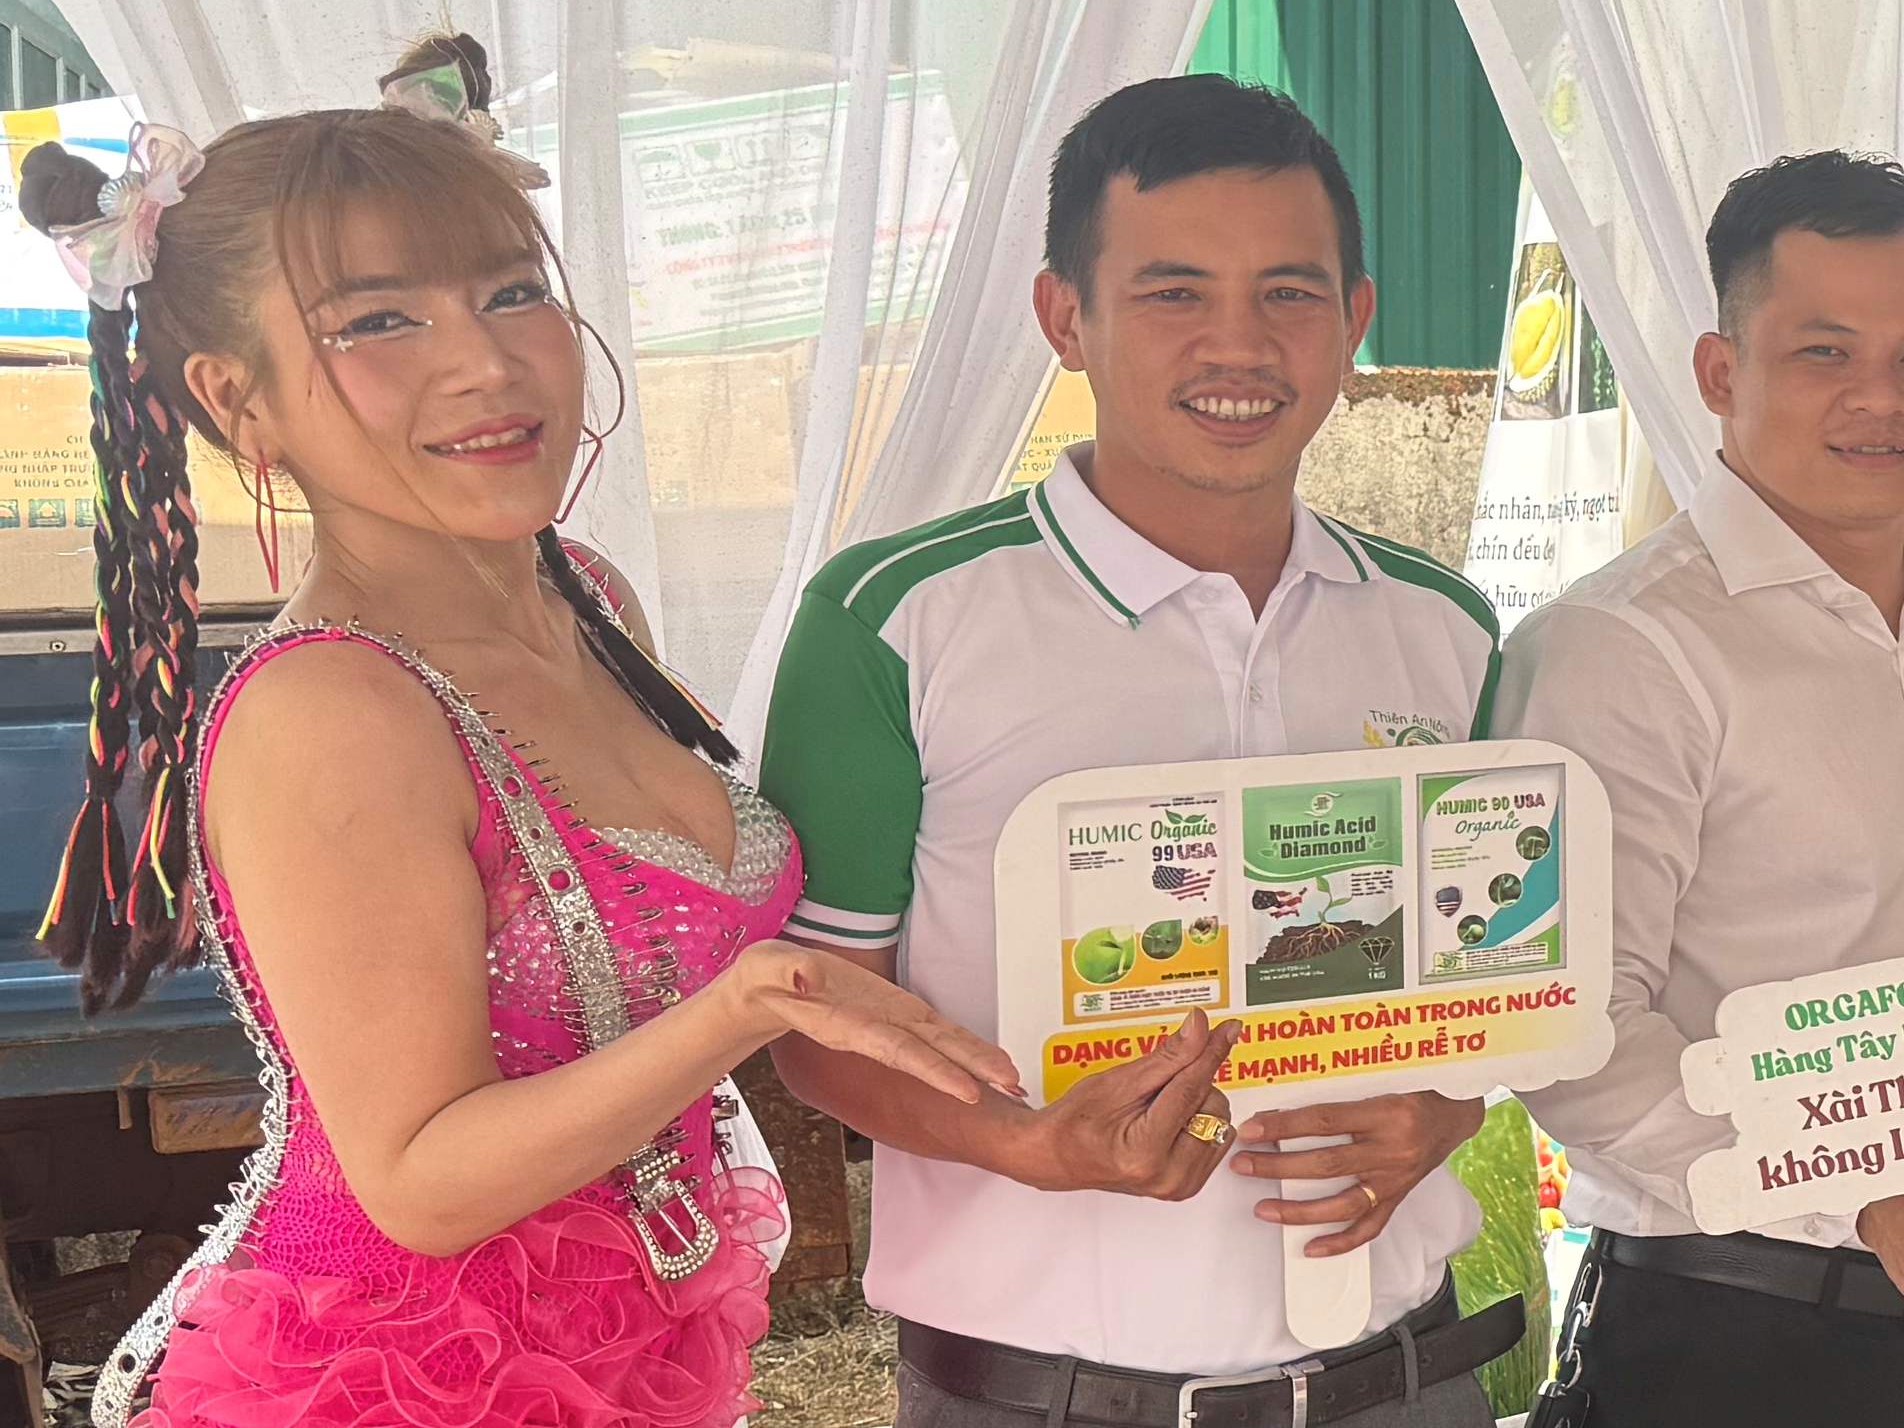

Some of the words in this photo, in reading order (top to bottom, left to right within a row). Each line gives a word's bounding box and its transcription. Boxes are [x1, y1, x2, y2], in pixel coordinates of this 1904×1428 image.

[1436, 797, 1489, 817] HUMIC
[1491, 796, 1511, 813] 90
[1513, 793, 1546, 810] USA
[1069, 823, 1142, 846] HUMIC
[1150, 819, 1218, 842] Organic
[1270, 821, 1330, 840] Humic
[1335, 816, 1376, 835] Acid
[1454, 812, 1521, 834] Organic
[1152, 845, 1174, 862] 99
[1177, 842, 1218, 861] USA
[1280, 836, 1366, 859] Diamond
[1052, 1038, 1132, 1070] DẠNG
[1265, 1004, 1337, 1043] HOÀN
[1340, 1003, 1411, 1038] TOÀN
[1416, 995, 1501, 1029] TRONG
[1506, 982, 1576, 1015] NƯỚC
[1238, 1052, 1326, 1088] MẠNH,
[1332, 1034, 1413, 1071] NHIỀU
[1453, 1030, 1486, 1053] TƠ
[1751, 1045, 1833, 1082] Hàng
[1836, 1031, 1897, 1067] Tây
[1798, 1088, 1867, 1131] Xài
[1757, 1142, 1887, 1192] không
